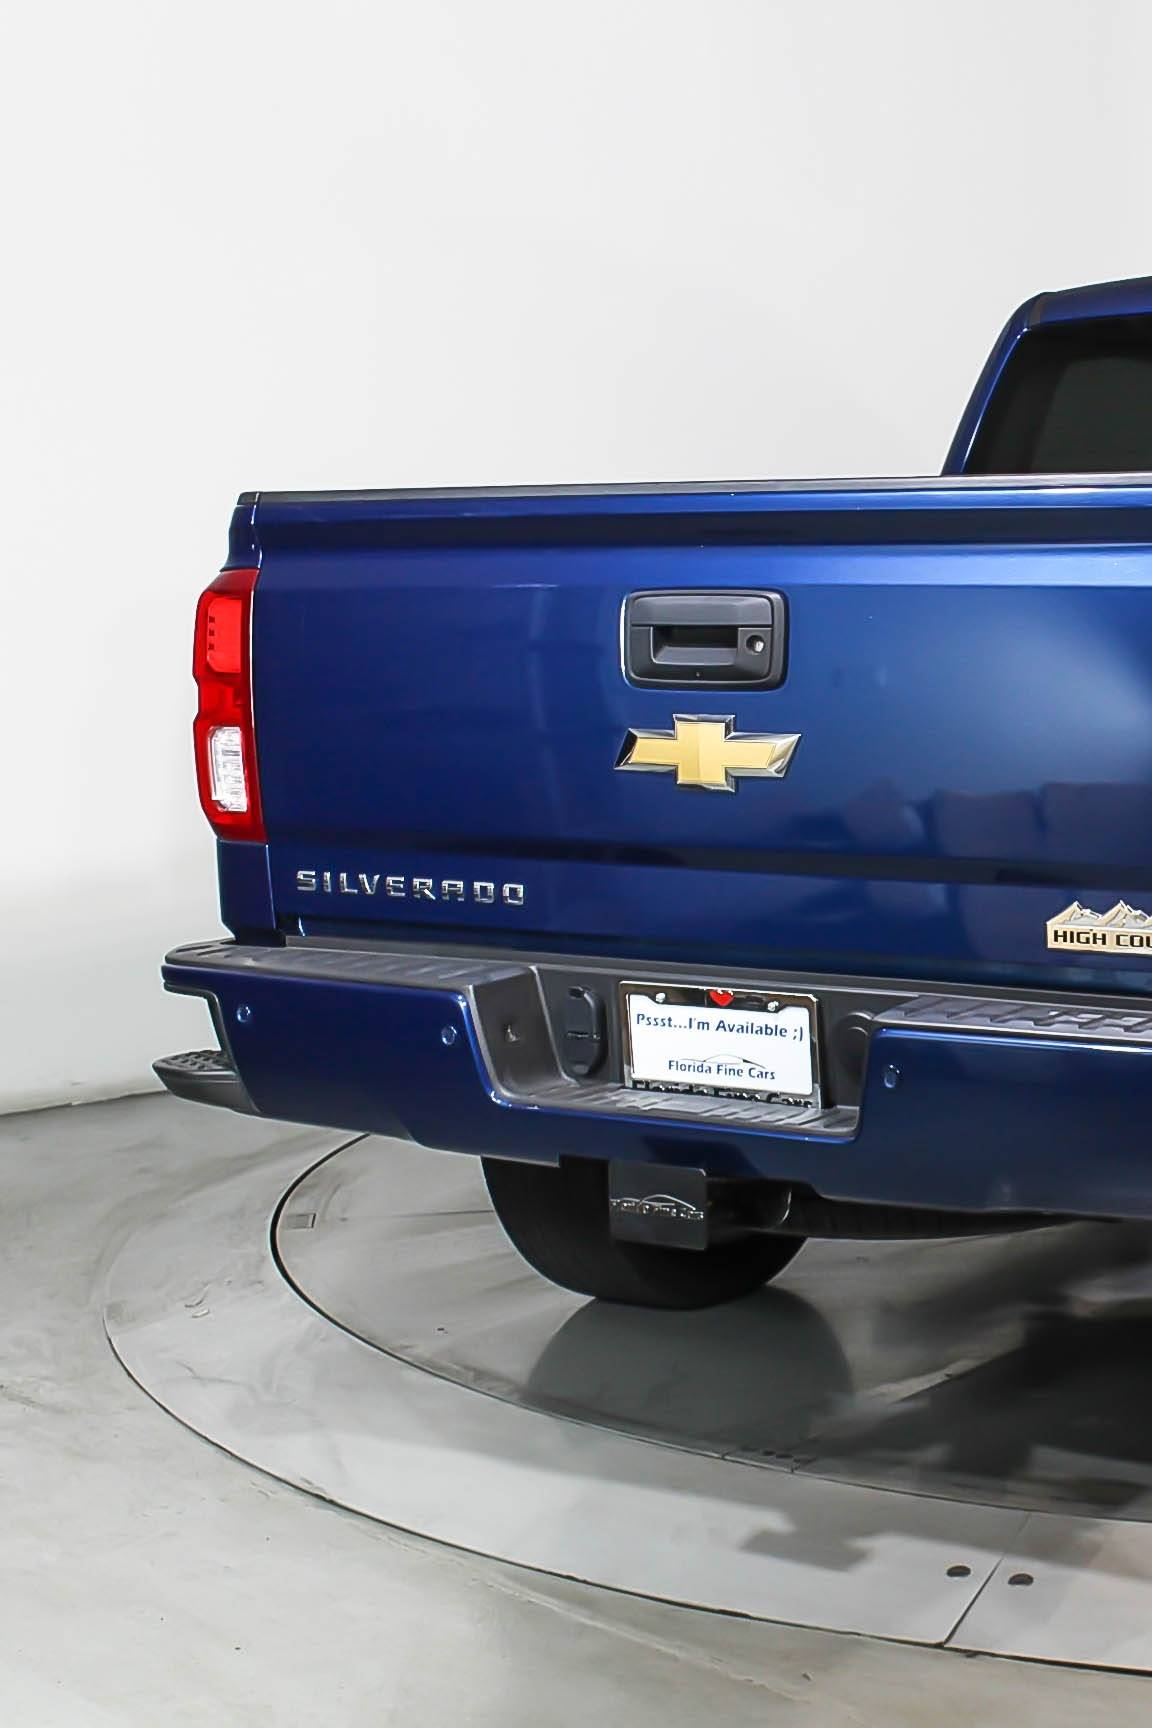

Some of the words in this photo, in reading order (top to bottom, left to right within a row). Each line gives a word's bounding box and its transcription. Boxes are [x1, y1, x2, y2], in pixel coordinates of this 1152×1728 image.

[296, 870, 524, 905] SILVERADO
[1053, 930, 1107, 945] HIGH
[715, 1019, 788, 1037] Available
[668, 1060, 712, 1075] Florida
[716, 1063, 744, 1077] Fine
[748, 1067, 776, 1080] Cars
